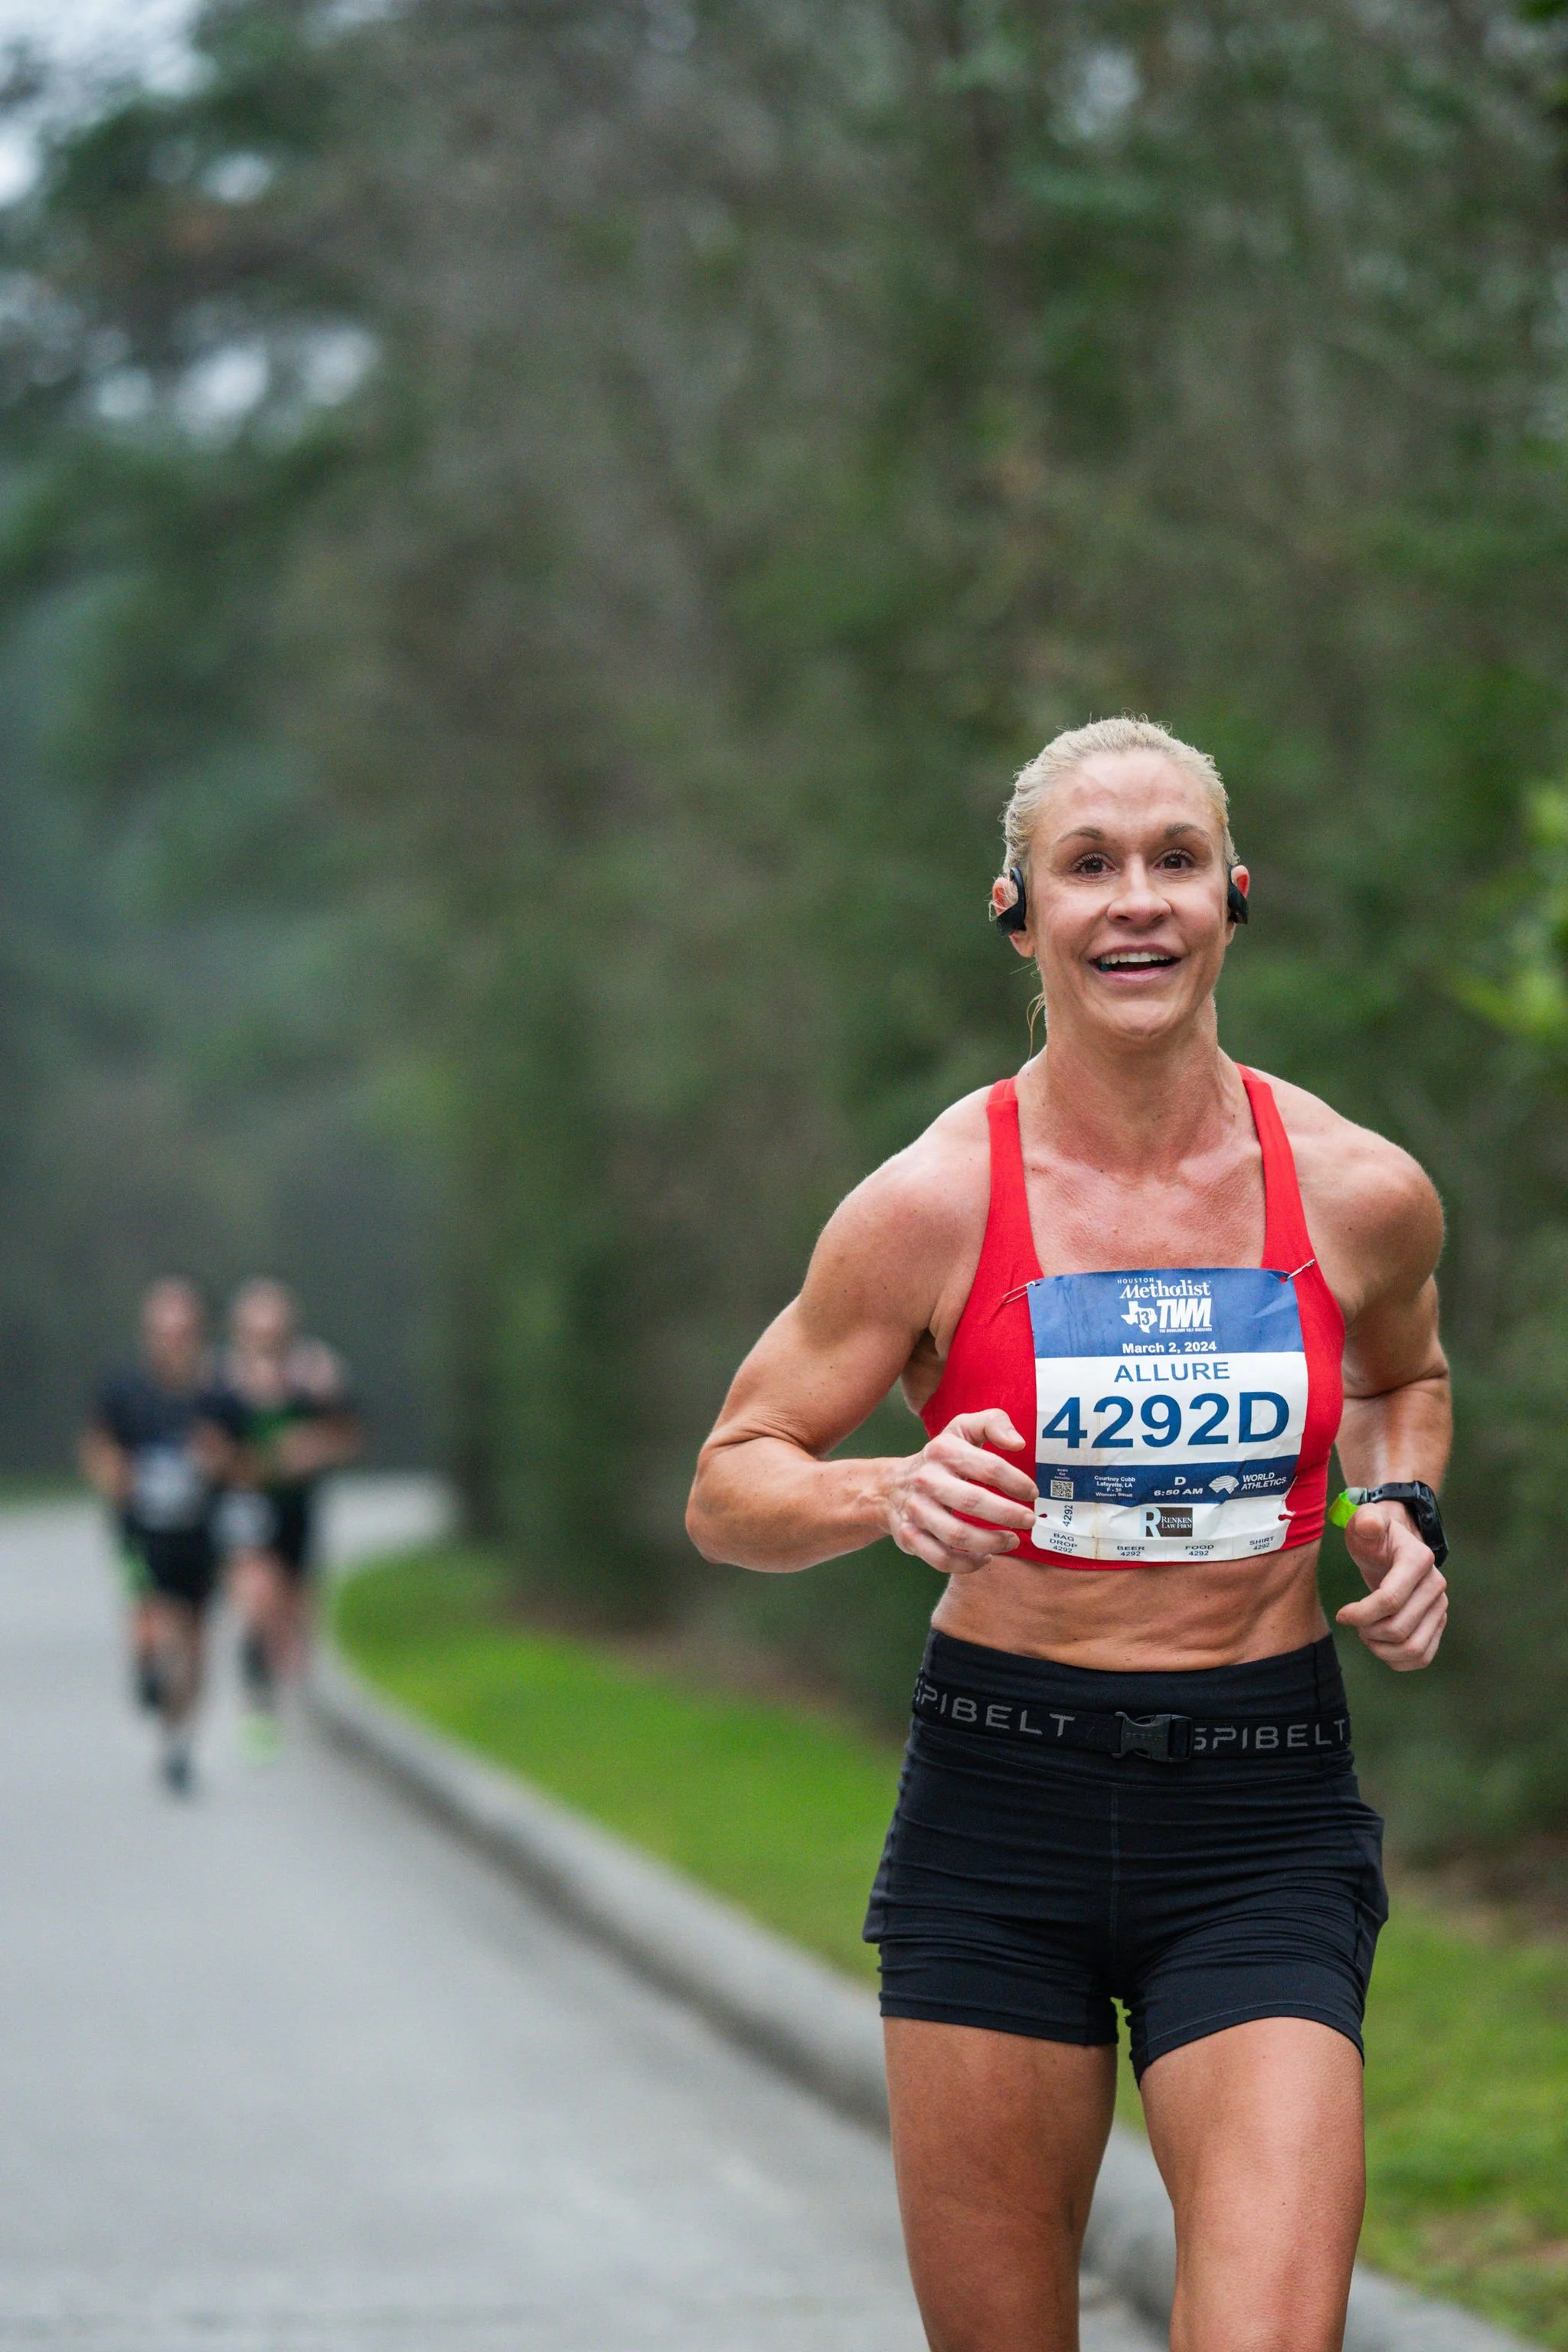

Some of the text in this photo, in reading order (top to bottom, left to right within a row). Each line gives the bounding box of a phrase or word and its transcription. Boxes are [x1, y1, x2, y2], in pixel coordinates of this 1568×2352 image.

[1119, 1280, 1210, 1298] Methodist
[1156, 1298, 1212, 1328] TWM
[1122, 1341, 1217, 1354] March 2, 2024
[1114, 1361, 1230, 1383] ALLURE
[1041, 1391, 1290, 1449] 4292D
[1174, 1476, 1186, 1485] D
[1240, 1476, 1287, 1491] ATHLETICS
[1243, 1472, 1275, 1483] WORLD
[1063, 1504, 1073, 1527] 4292
[1140, 1507, 1161, 1537] R
[1050, 1538, 1077, 1547] DROP
[1054, 1533, 1074, 1542] BAG
[1250, 1536, 1275, 1545] SHIRT
[1054, 1545, 1073, 1553] 4292
[1194, 1720, 1345, 1750] SPIBELT
